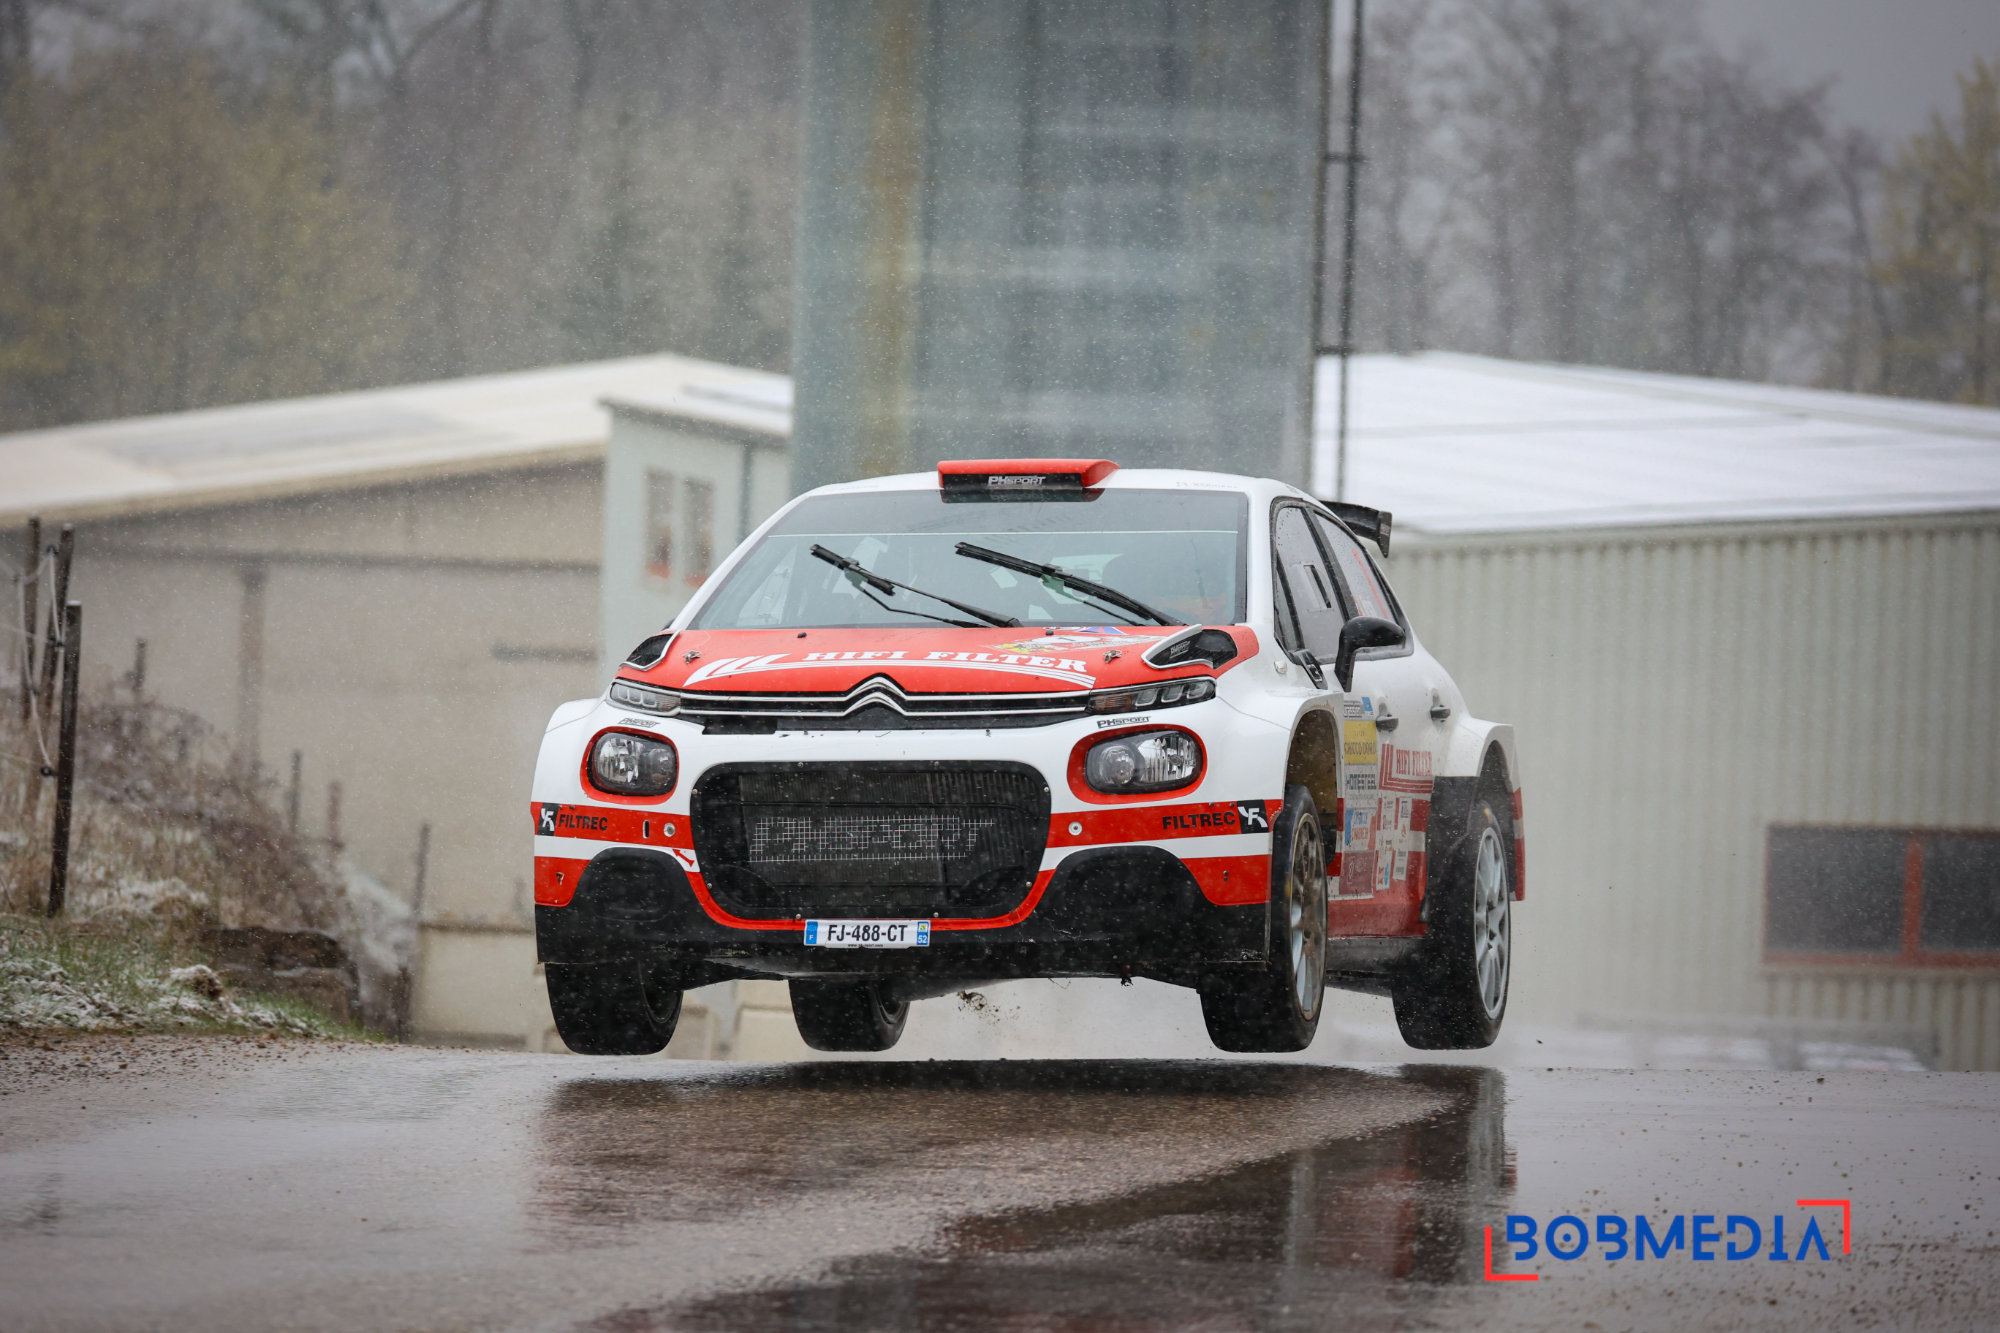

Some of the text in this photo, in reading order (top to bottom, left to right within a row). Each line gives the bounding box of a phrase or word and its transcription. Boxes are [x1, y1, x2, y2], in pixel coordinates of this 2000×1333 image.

[802, 650, 1088, 673] HIFI FILTER
[558, 813, 609, 831] FILTREC
[1162, 811, 1236, 830] FILTREC
[827, 924, 909, 942] FJ-488-CT
[917, 934, 928, 944] 52
